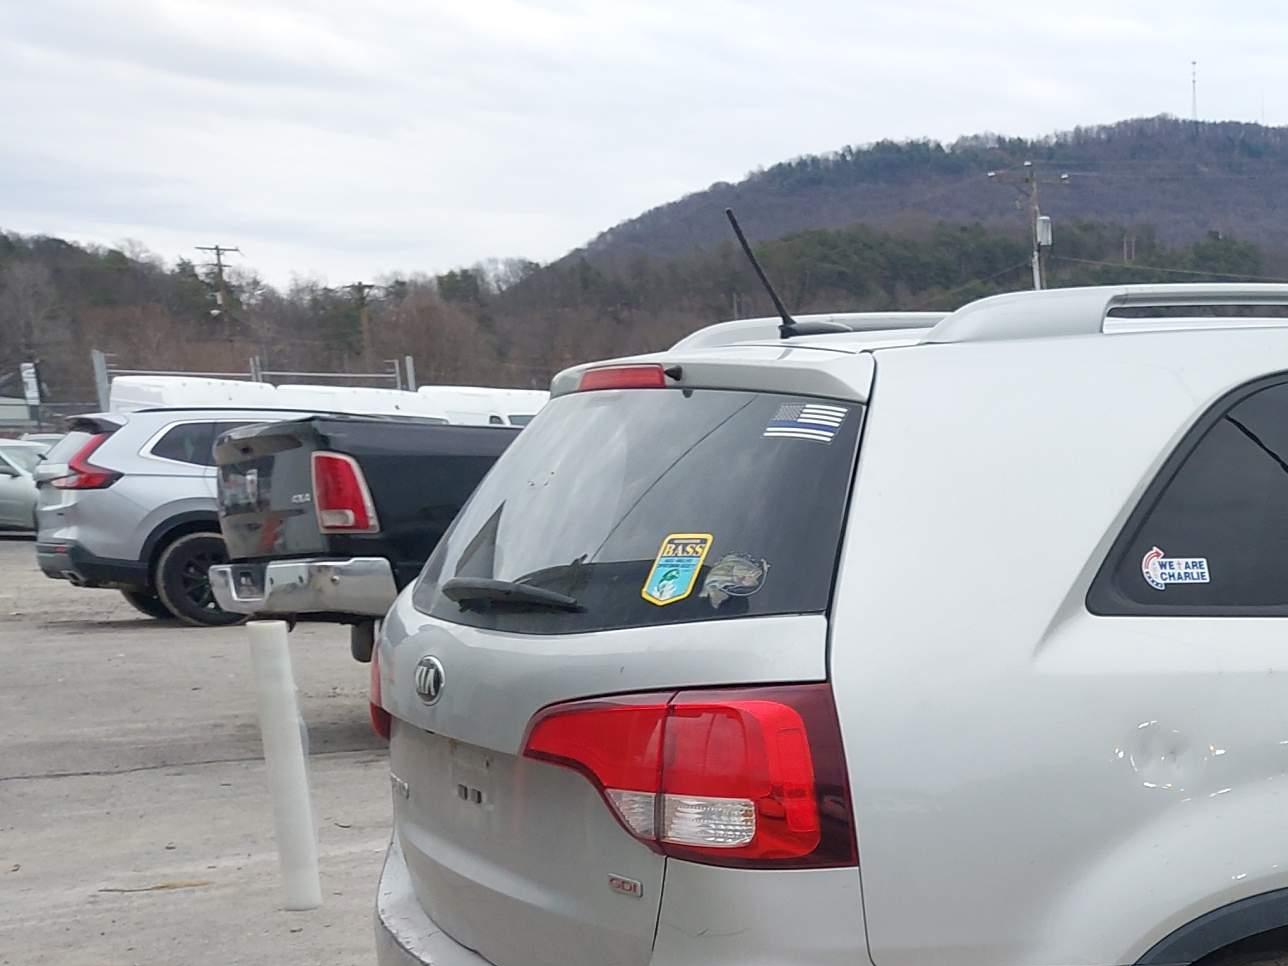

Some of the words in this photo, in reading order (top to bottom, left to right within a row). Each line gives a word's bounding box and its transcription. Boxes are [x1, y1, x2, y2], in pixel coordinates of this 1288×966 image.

[663, 543, 706, 557] BASS
[1158, 561, 1175, 570] WE
[1185, 560, 1205, 570] ARE
[1160, 571, 1207, 582] CHARLIE
